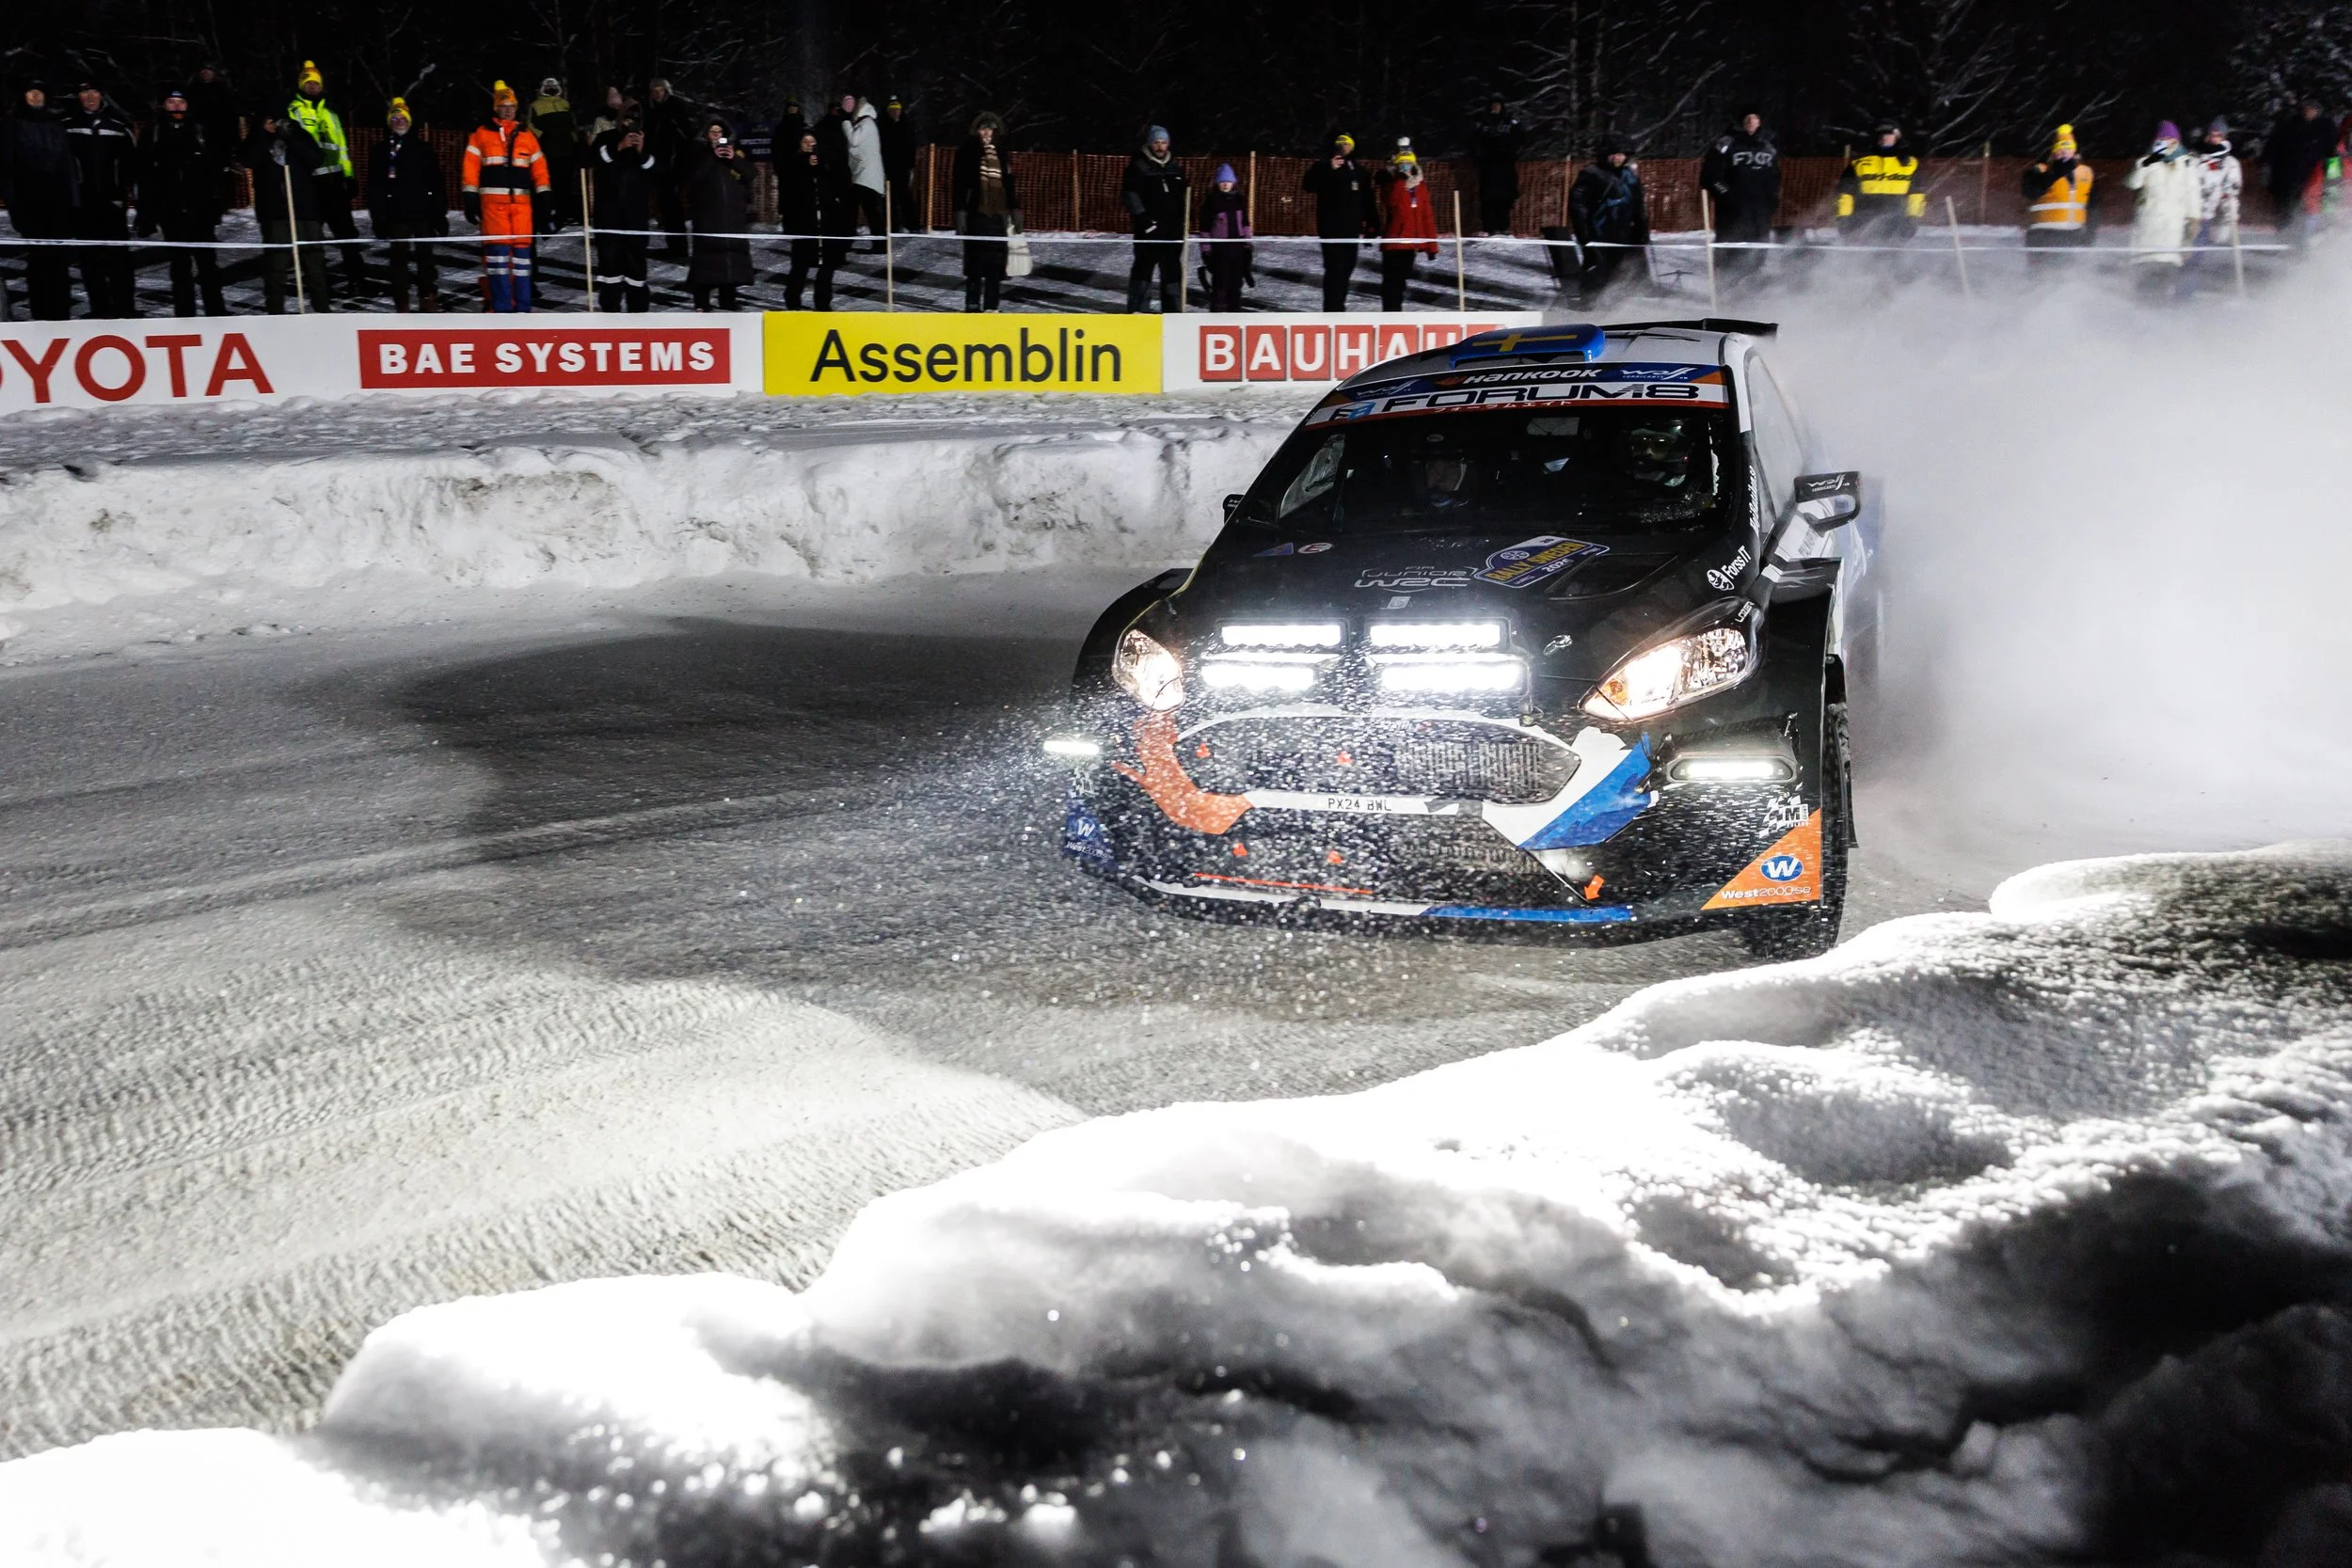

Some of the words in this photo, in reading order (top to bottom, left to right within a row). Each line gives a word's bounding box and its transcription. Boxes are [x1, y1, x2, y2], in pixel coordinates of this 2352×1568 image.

[0, 333, 275, 404] YOTA
[378, 342, 476, 375] BAE
[494, 341, 716, 373] SYSTEMS
[810, 326, 1121, 384] Assemblin
[1381, 384, 1700, 412] FORUM8
[1484, 561, 1535, 581] RALLY
[1527, 541, 1586, 564] SWEDEN
[1354, 577, 1471, 588] WRC
[1327, 798, 1360, 810] PX24
[1367, 800, 1392, 812] BWL
[1767, 857, 1799, 879] W
